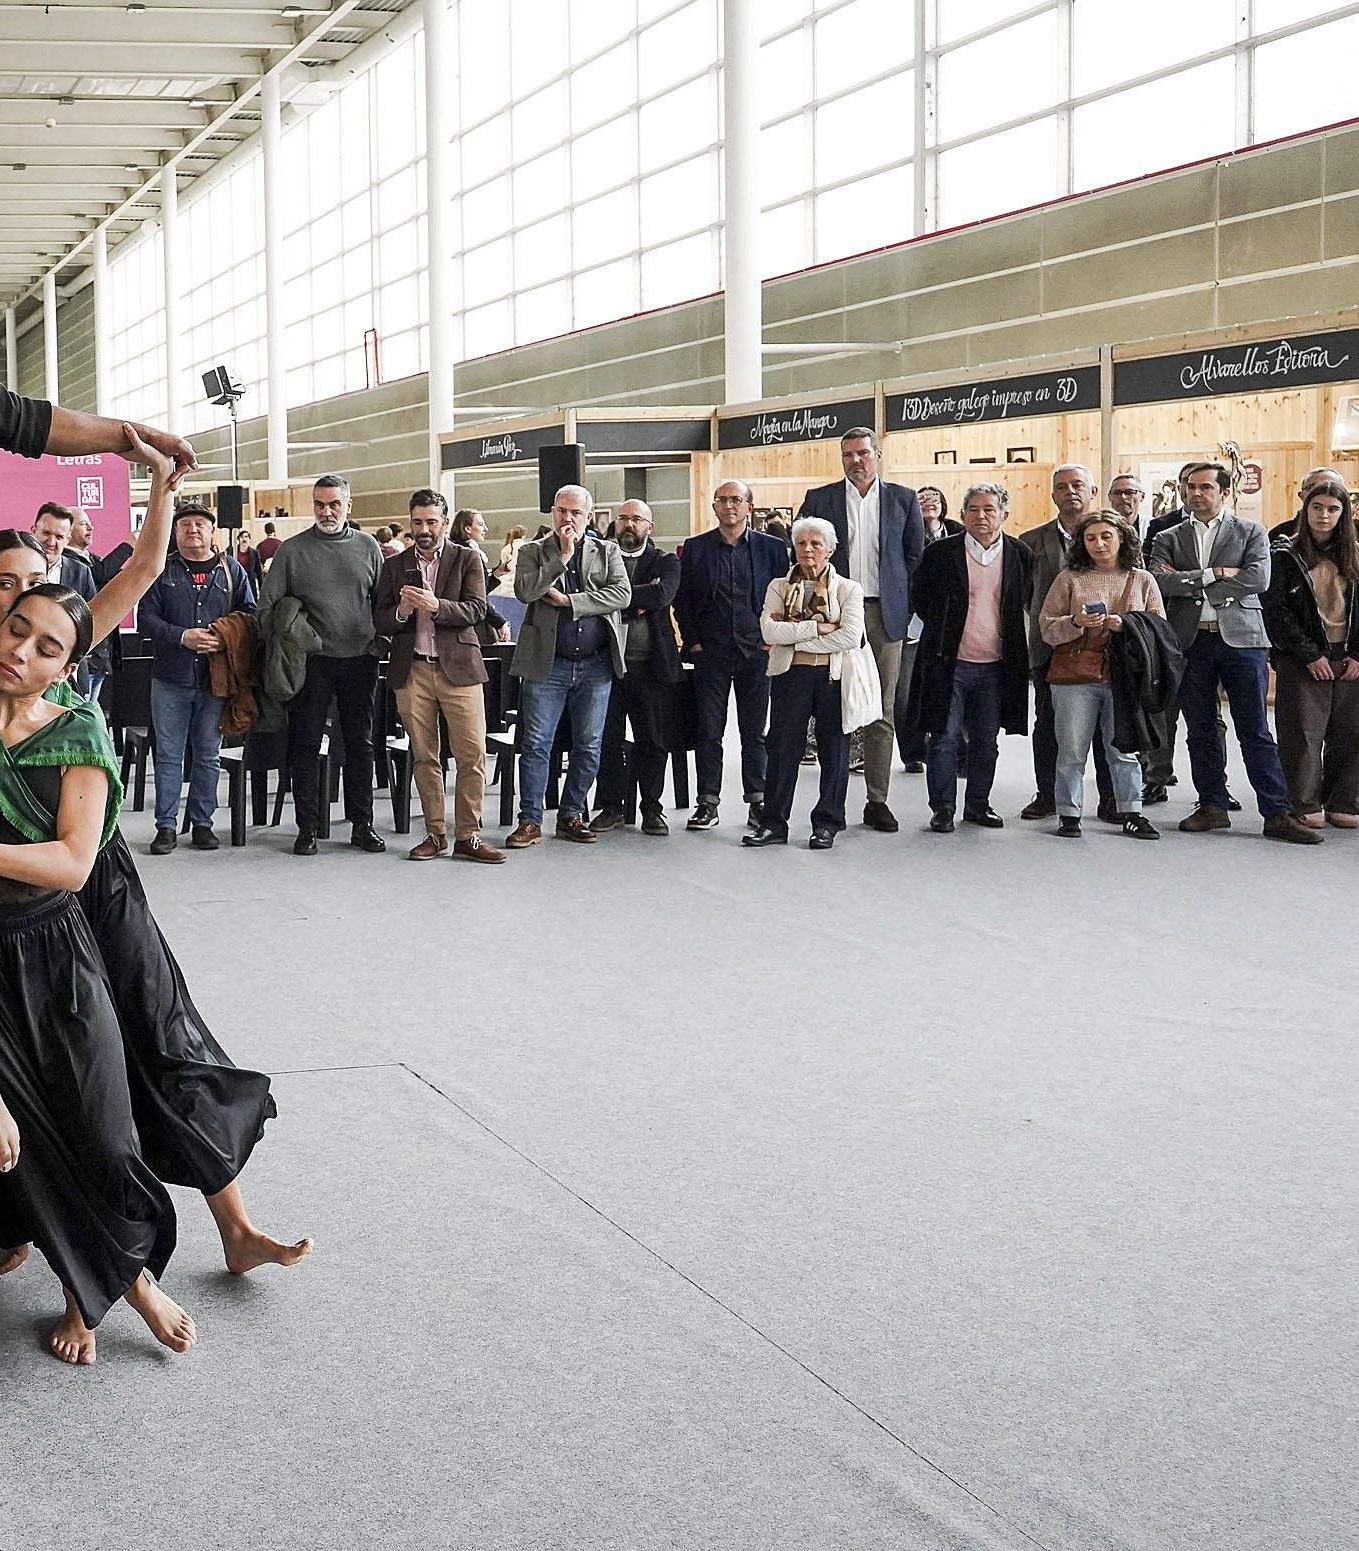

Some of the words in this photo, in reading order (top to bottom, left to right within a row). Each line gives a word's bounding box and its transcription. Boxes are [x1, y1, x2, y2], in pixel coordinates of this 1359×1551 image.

[1180, 347, 1269, 391] Alvarellos
[1266, 340, 1349, 375] Editora
[954, 388, 990, 421] galego
[992, 389, 1033, 418] impreso
[1035, 387, 1050, 402] en
[1056, 377, 1077, 402] 3D
[750, 414, 783, 444] Magia
[799, 409, 837, 438] Manga
[56, 454, 103, 466] Letras
